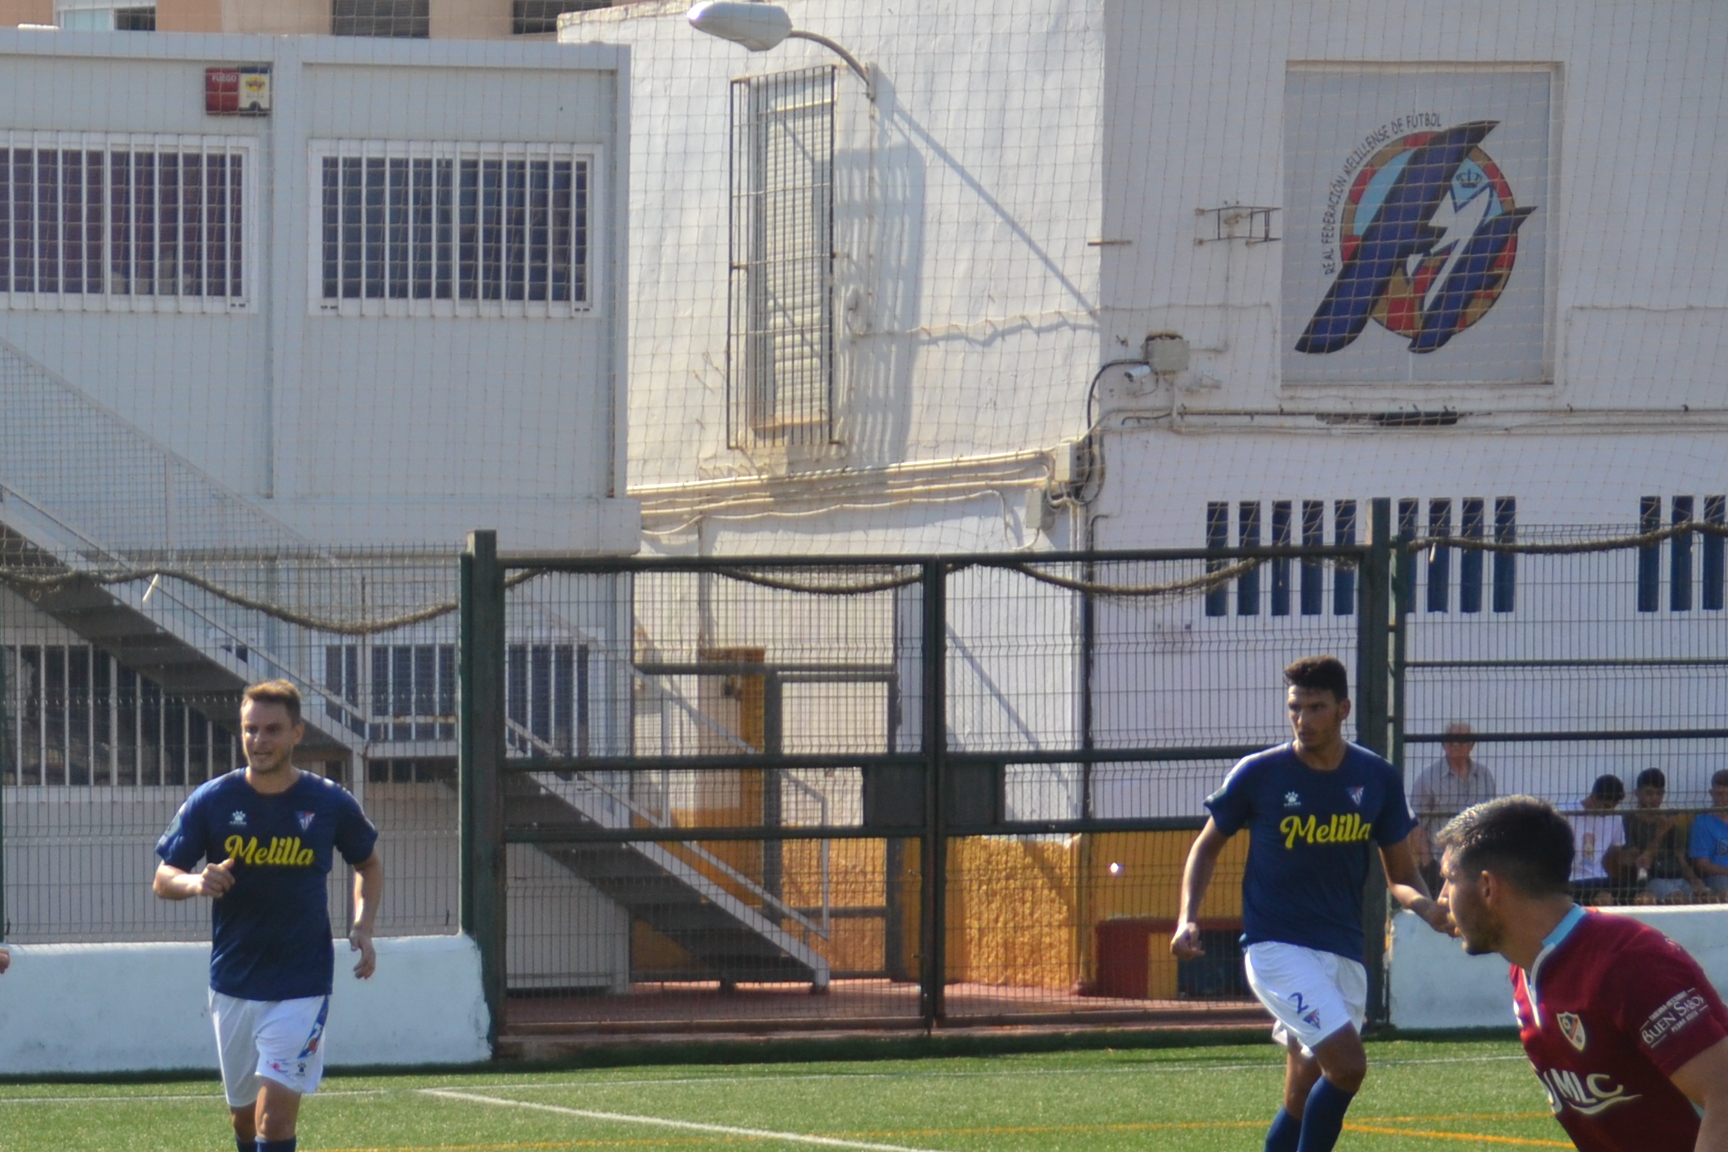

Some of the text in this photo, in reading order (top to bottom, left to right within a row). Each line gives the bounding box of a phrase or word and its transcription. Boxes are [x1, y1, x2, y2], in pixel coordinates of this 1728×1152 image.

[1391, 117, 1404, 134] DE
[1345, 124, 1390, 178] MELILLENSE
[1321, 175, 1346, 244] FEDERACIÓN
[1323, 247, 1335, 275] REAL
[1279, 812, 1372, 849] Melilla
[224, 834, 315, 867] Melilla
[1287, 991, 1310, 1015] 2
[1641, 1010, 1677, 1045] BUEN
[1549, 1068, 1624, 1104] MLC
